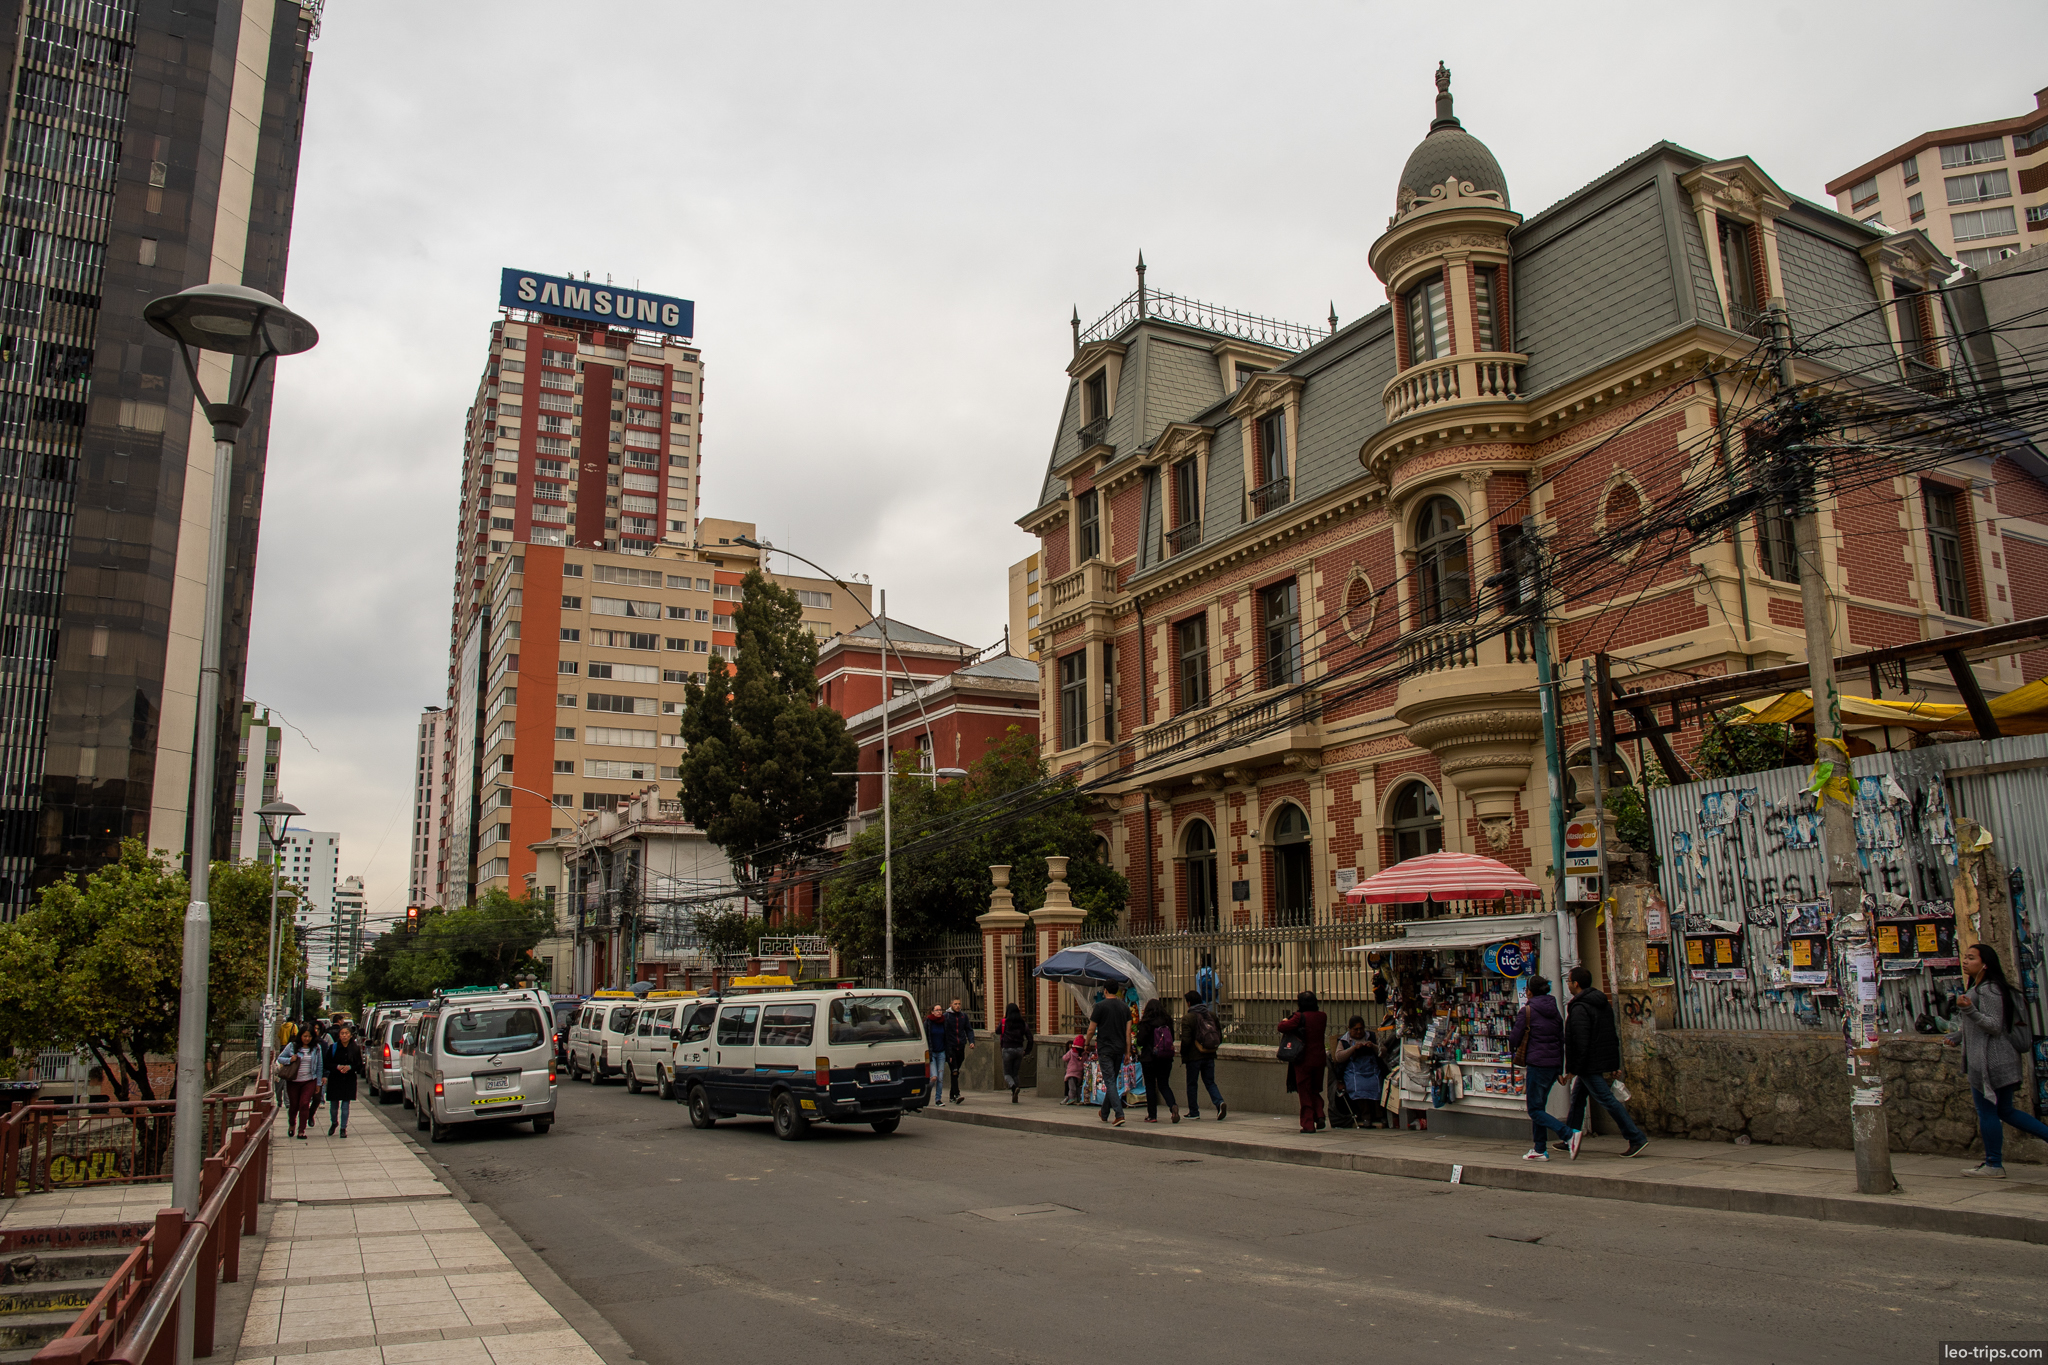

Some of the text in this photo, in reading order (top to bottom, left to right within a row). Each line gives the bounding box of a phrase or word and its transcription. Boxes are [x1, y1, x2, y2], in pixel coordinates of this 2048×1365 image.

[518, 277, 680, 327] SAMSUNG
[1567, 831, 1597, 840] MasterCard
[1574, 858, 1589, 866] VISA
[1501, 955, 1521, 966] tigo
[58, 1231, 71, 1243] LA
[78, 1229, 118, 1242] GUERRA
[121, 1228, 132, 1238] DE
